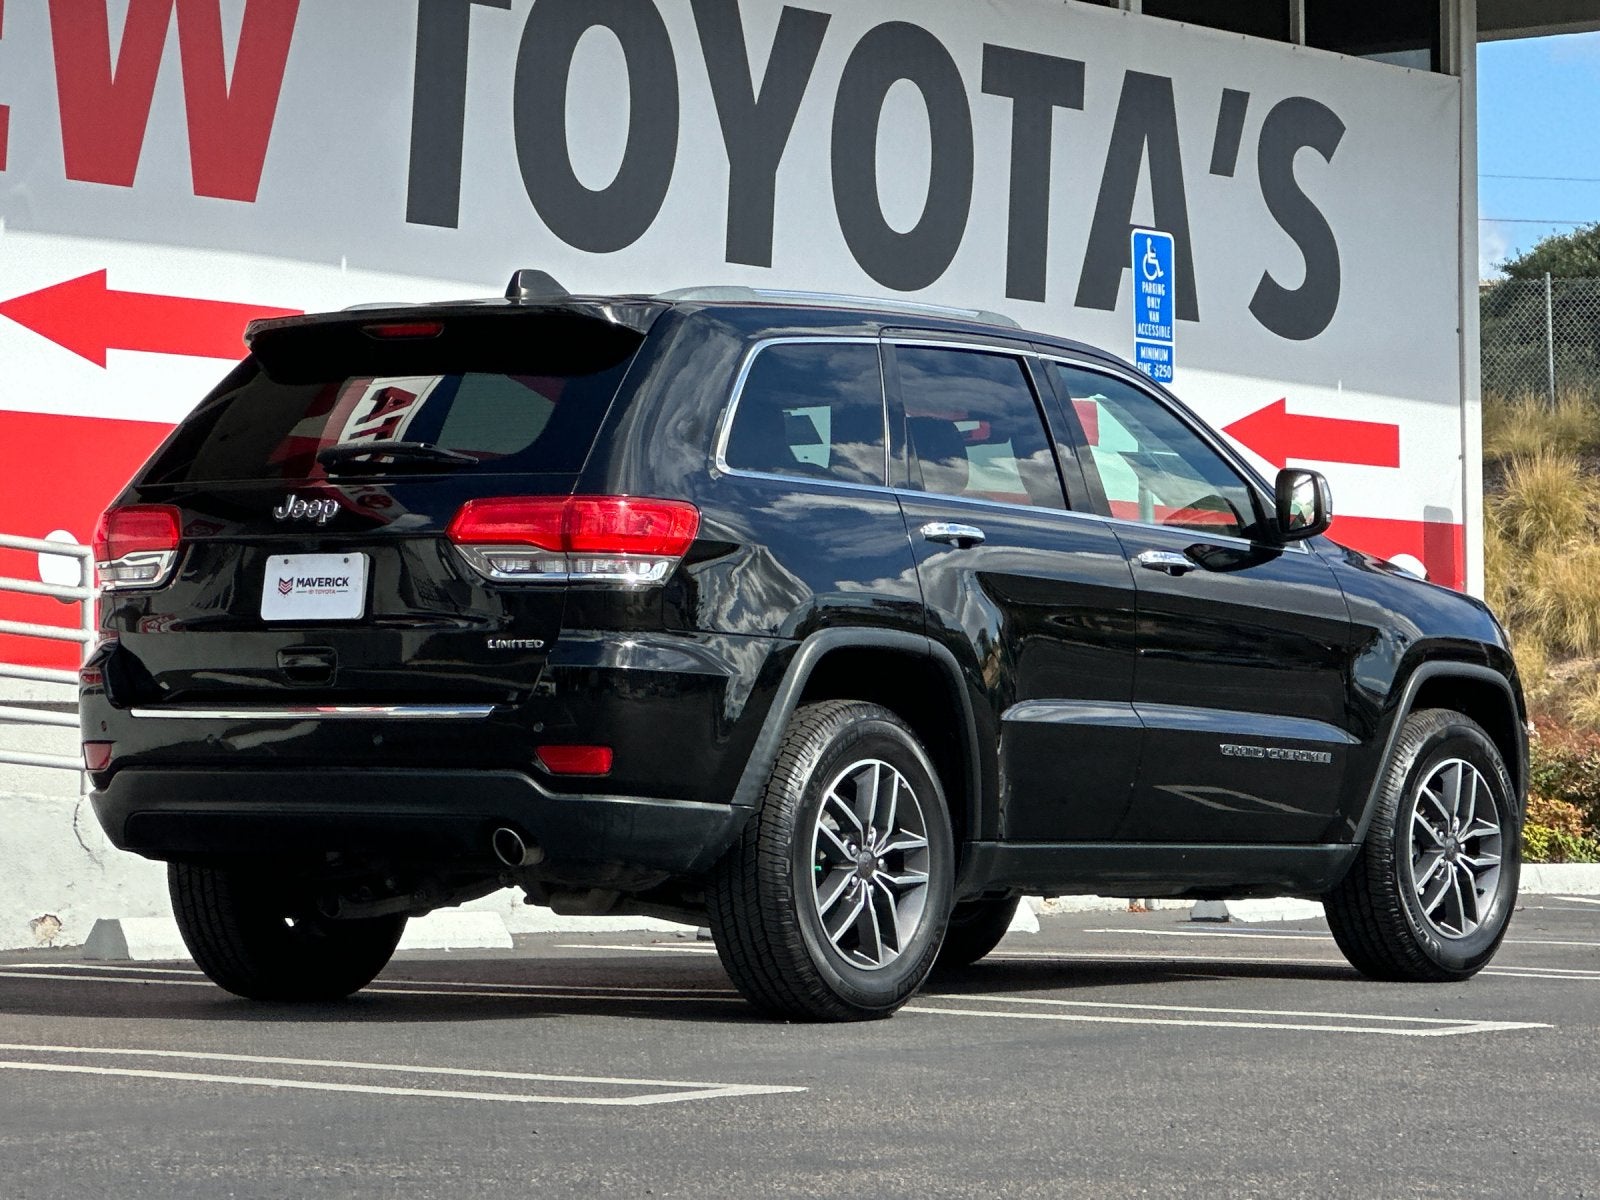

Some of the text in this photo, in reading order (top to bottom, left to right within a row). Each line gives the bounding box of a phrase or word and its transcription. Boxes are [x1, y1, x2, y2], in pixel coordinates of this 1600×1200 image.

[0, 0, 1347, 341] W TOYOTA'S
[1142, 281, 1166, 296] PARKING
[1146, 296, 1161, 309] ONLY
[1148, 310, 1160, 323] VAN
[1137, 323, 1171, 338] ACCESSIBLE
[1140, 346, 1169, 361] MINIMUM
[1154, 363, 1172, 378] $250
[273, 494, 340, 526] Jeep
[296, 577, 349, 587] MAVERICK
[487, 639, 545, 649] LIMITED
